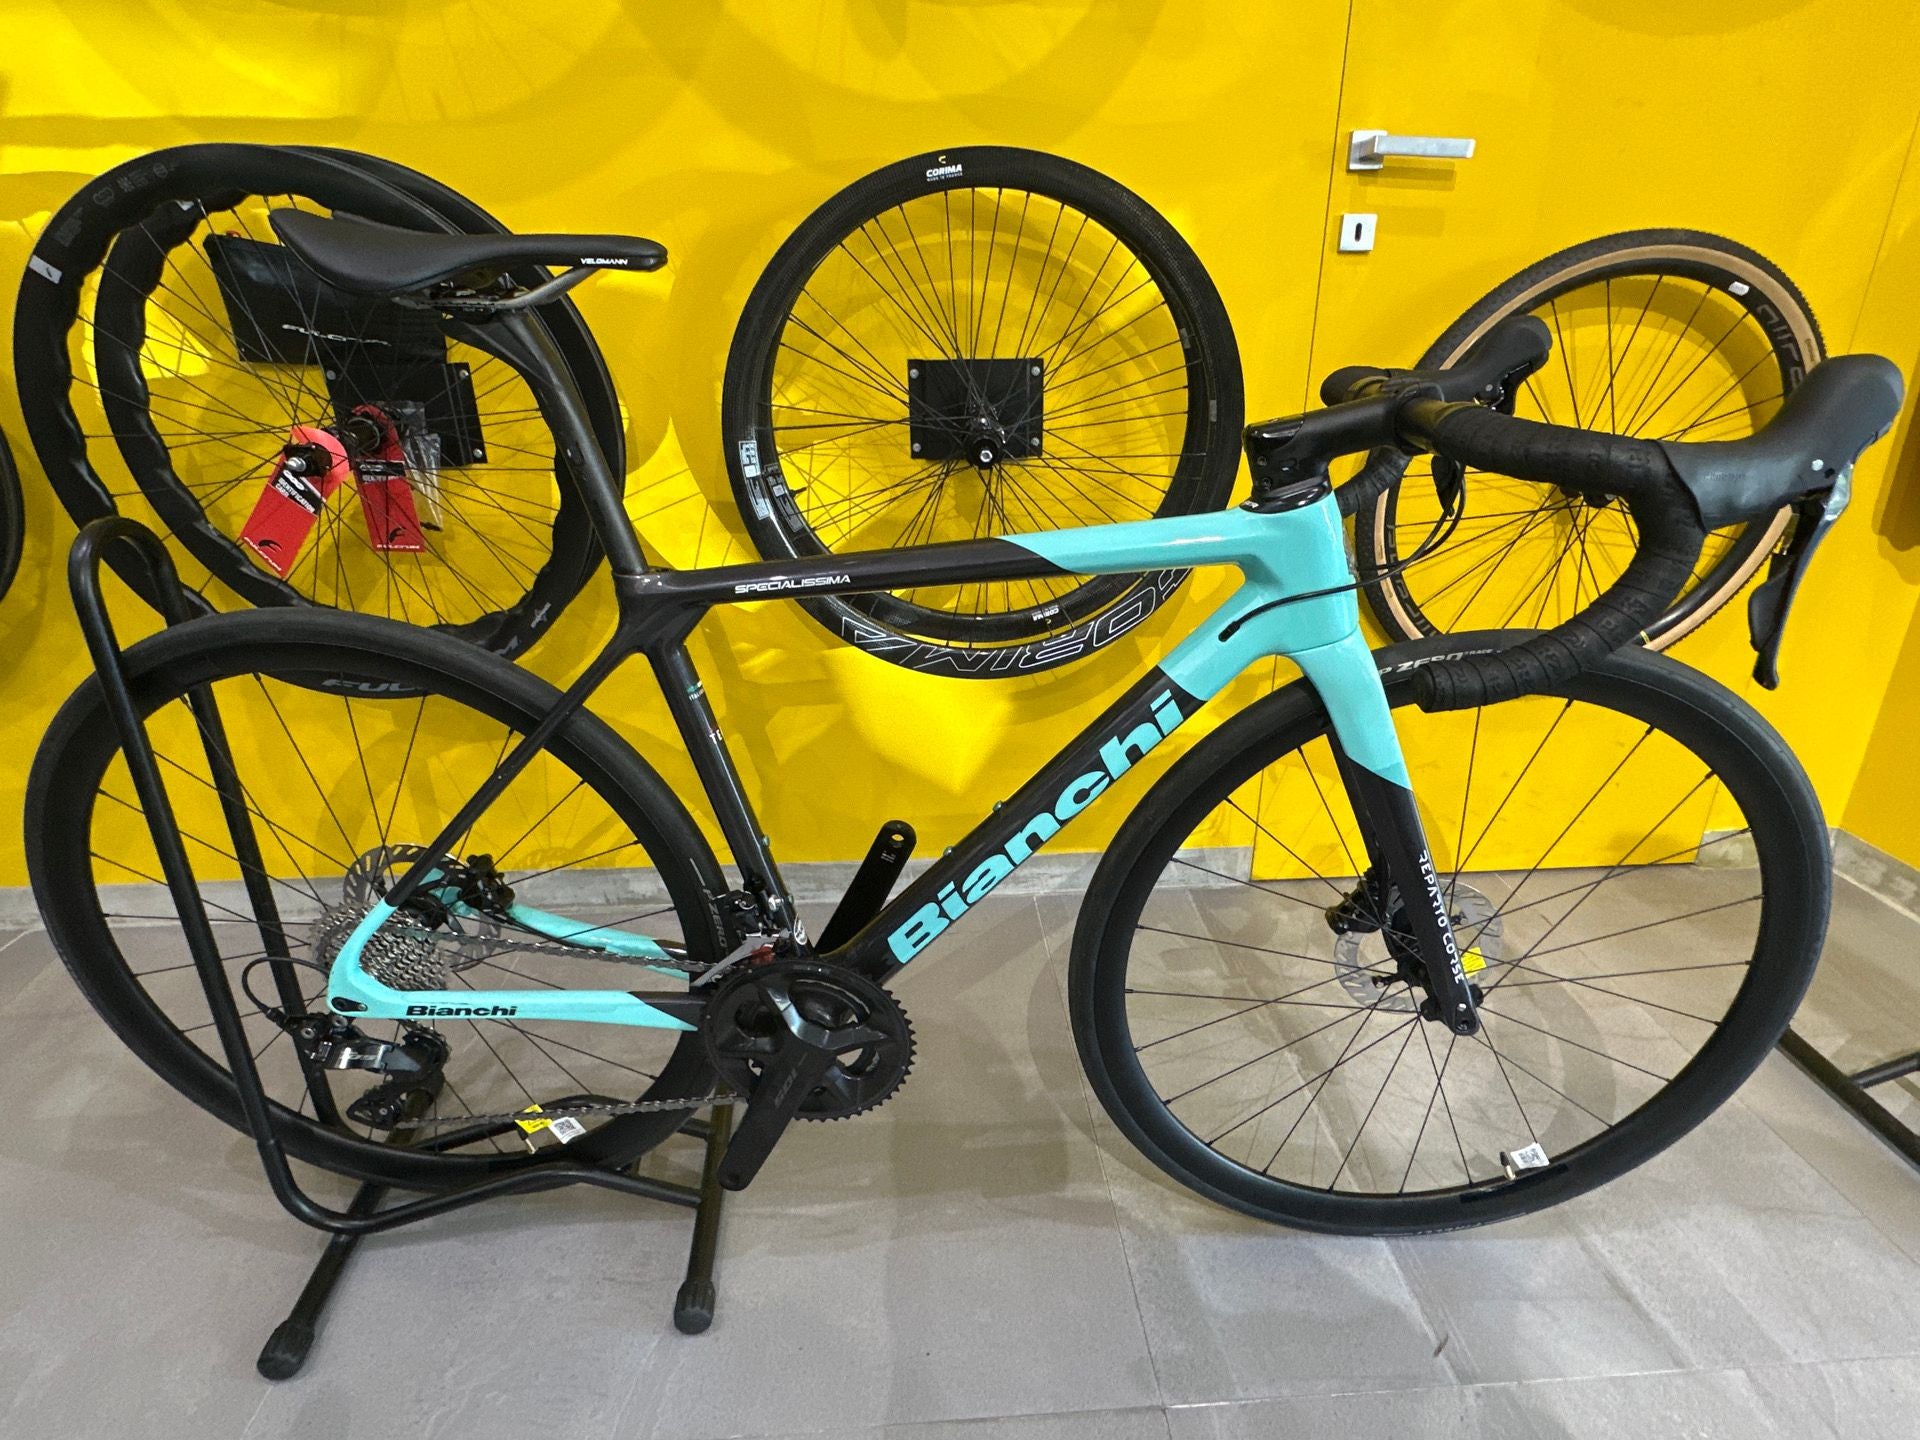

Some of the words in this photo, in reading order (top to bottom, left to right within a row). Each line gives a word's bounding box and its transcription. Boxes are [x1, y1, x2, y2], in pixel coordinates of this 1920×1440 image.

[926, 164, 962, 177] CORIMA
[735, 574, 851, 594] SPECIALISSIMA
[887, 688, 1185, 965] Bianchi
[1419, 849, 1449, 928] REPARTO
[1442, 932, 1465, 985] CORSE
[406, 1005, 518, 1016] Bianchi
